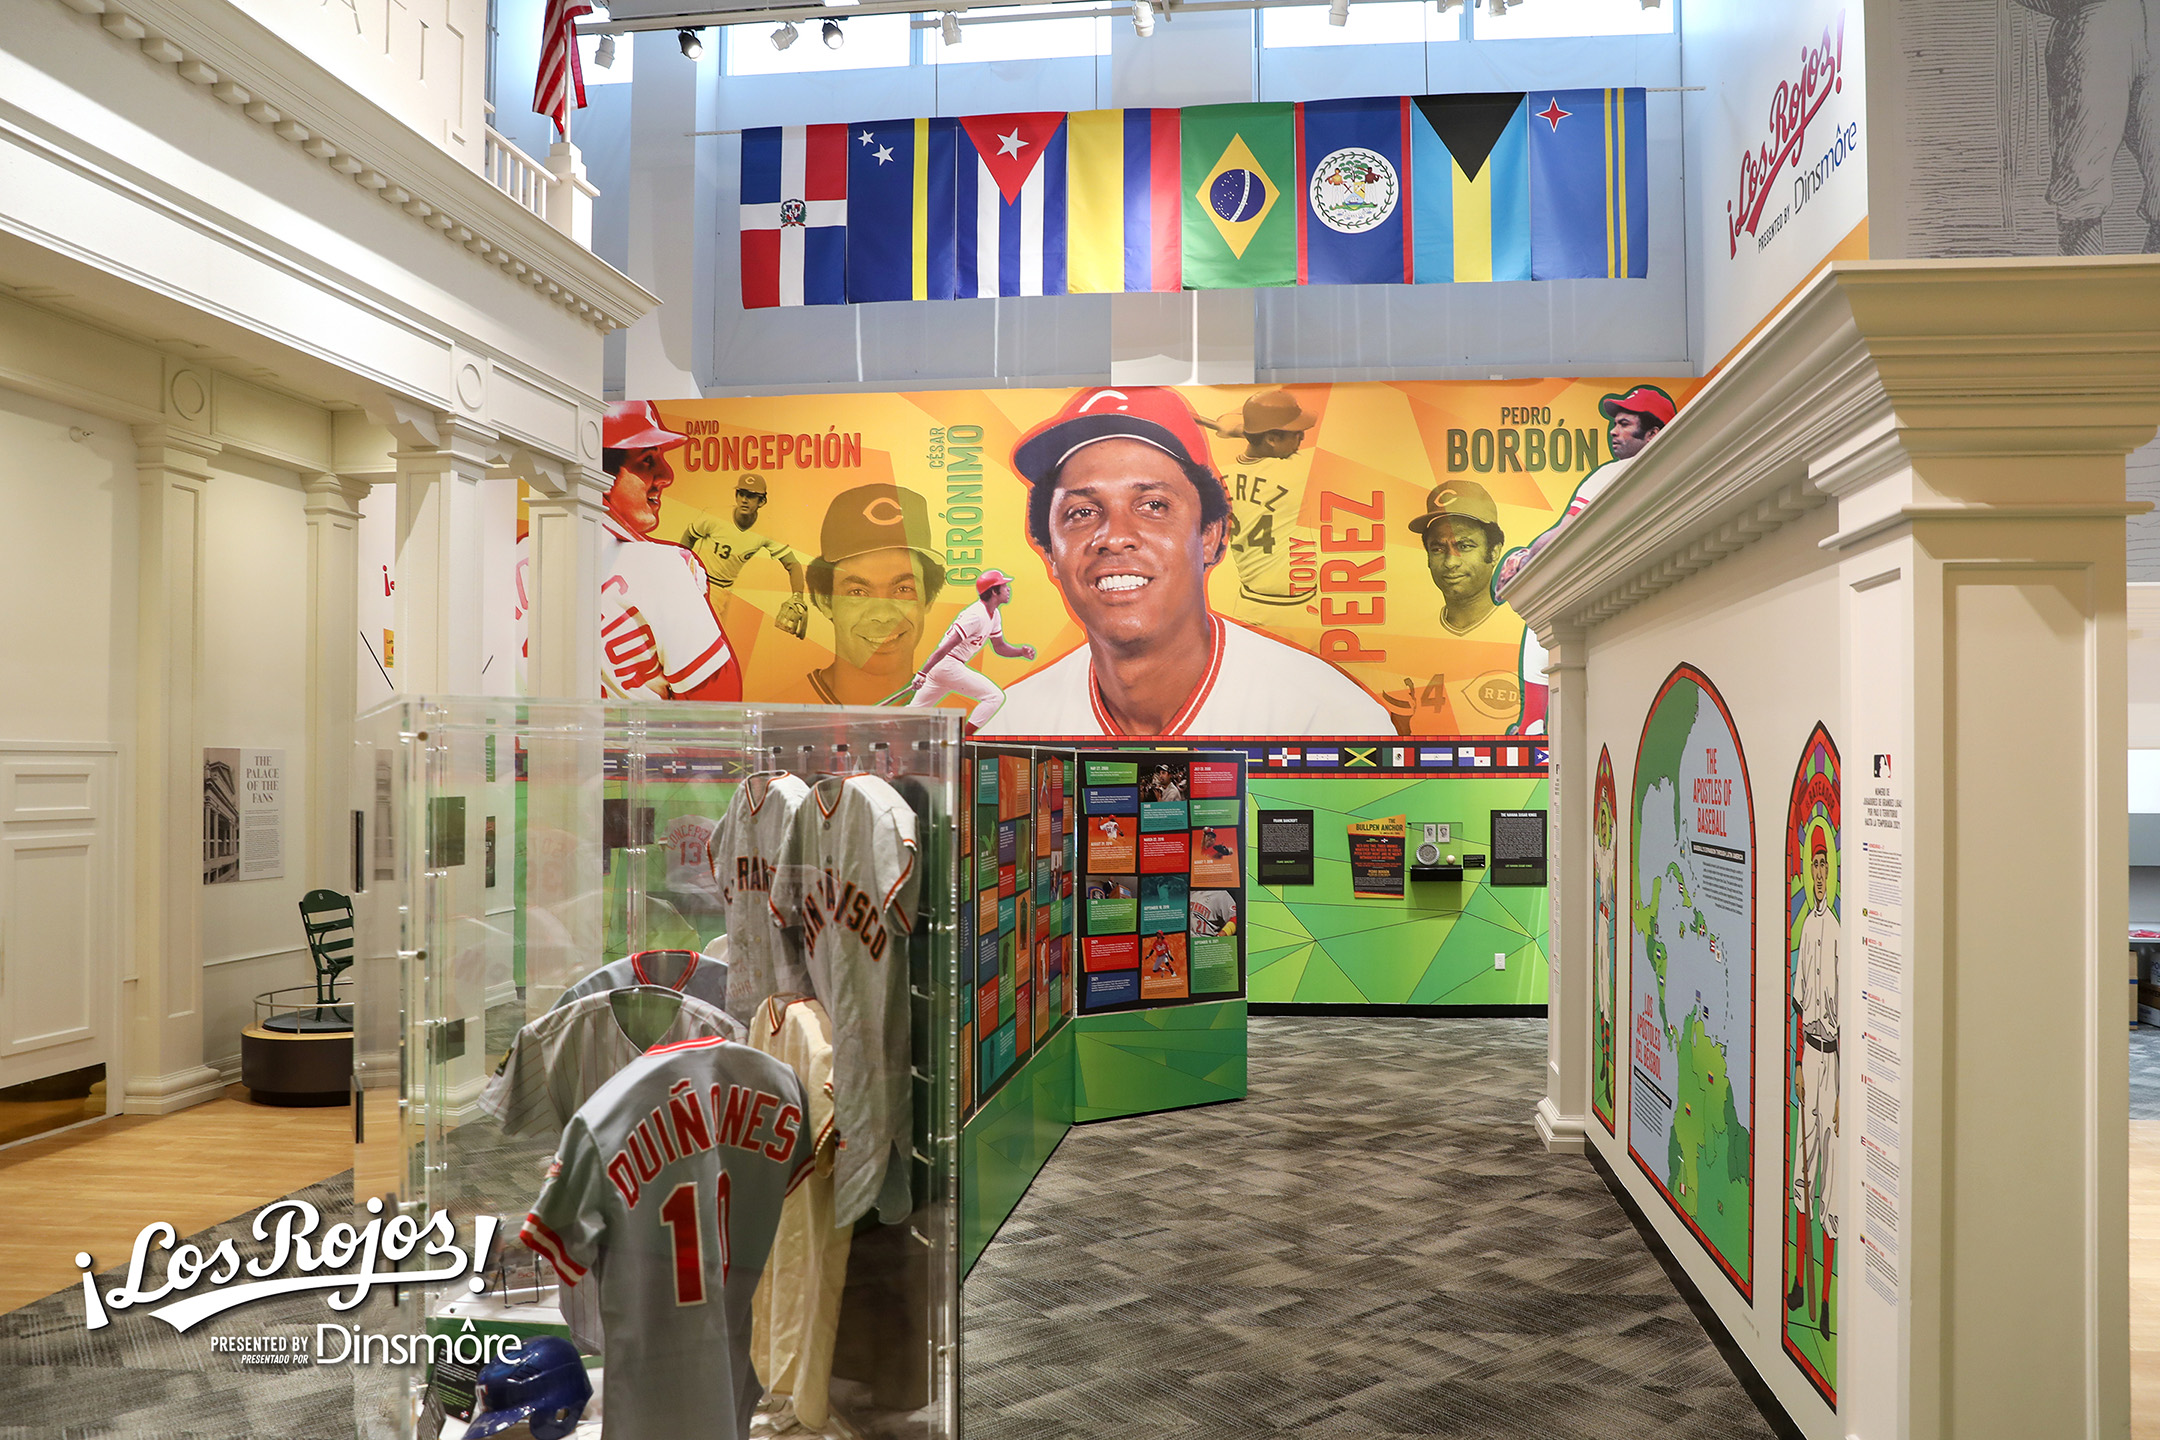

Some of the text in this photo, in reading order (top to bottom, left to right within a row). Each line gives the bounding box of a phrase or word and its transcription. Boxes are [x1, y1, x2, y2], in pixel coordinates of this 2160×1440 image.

[1768, 8, 1846, 168] Rojos!
[1794, 121, 1857, 215] Dinsmôre
[1758, 203, 1792, 254] PRESENTED BY
[686, 419, 720, 436] DAVID
[1501, 406, 1551, 425] PEDRO
[684, 425, 862, 472] CONCEPCIÓN
[929, 427, 946, 470] CÉSAR
[1446, 419, 1600, 474] BORBÓN
[938, 424, 985, 587] GERÓNIMO
[713, 542, 732, 560] 13
[1289, 536, 1317, 597] TONY
[1307, 490, 1388, 664] PÉREZ
[246, 768, 280, 778] PALACE
[254, 755, 272, 766] THE
[1706, 748, 1717, 774] THE
[246, 780, 280, 791] OF THE
[252, 793, 274, 803] FANS
[1693, 778, 1732, 806] APOSTLES OF
[1381, 824, 1404, 832] ANCHOR
[1697, 807, 1727, 837] BASEBALL
[680, 841, 701, 866] 13
[1644, 992, 1653, 1019] LOS
[607, 1078, 802, 1210] QUIÑONES
[660, 1168, 731, 1308] 10
